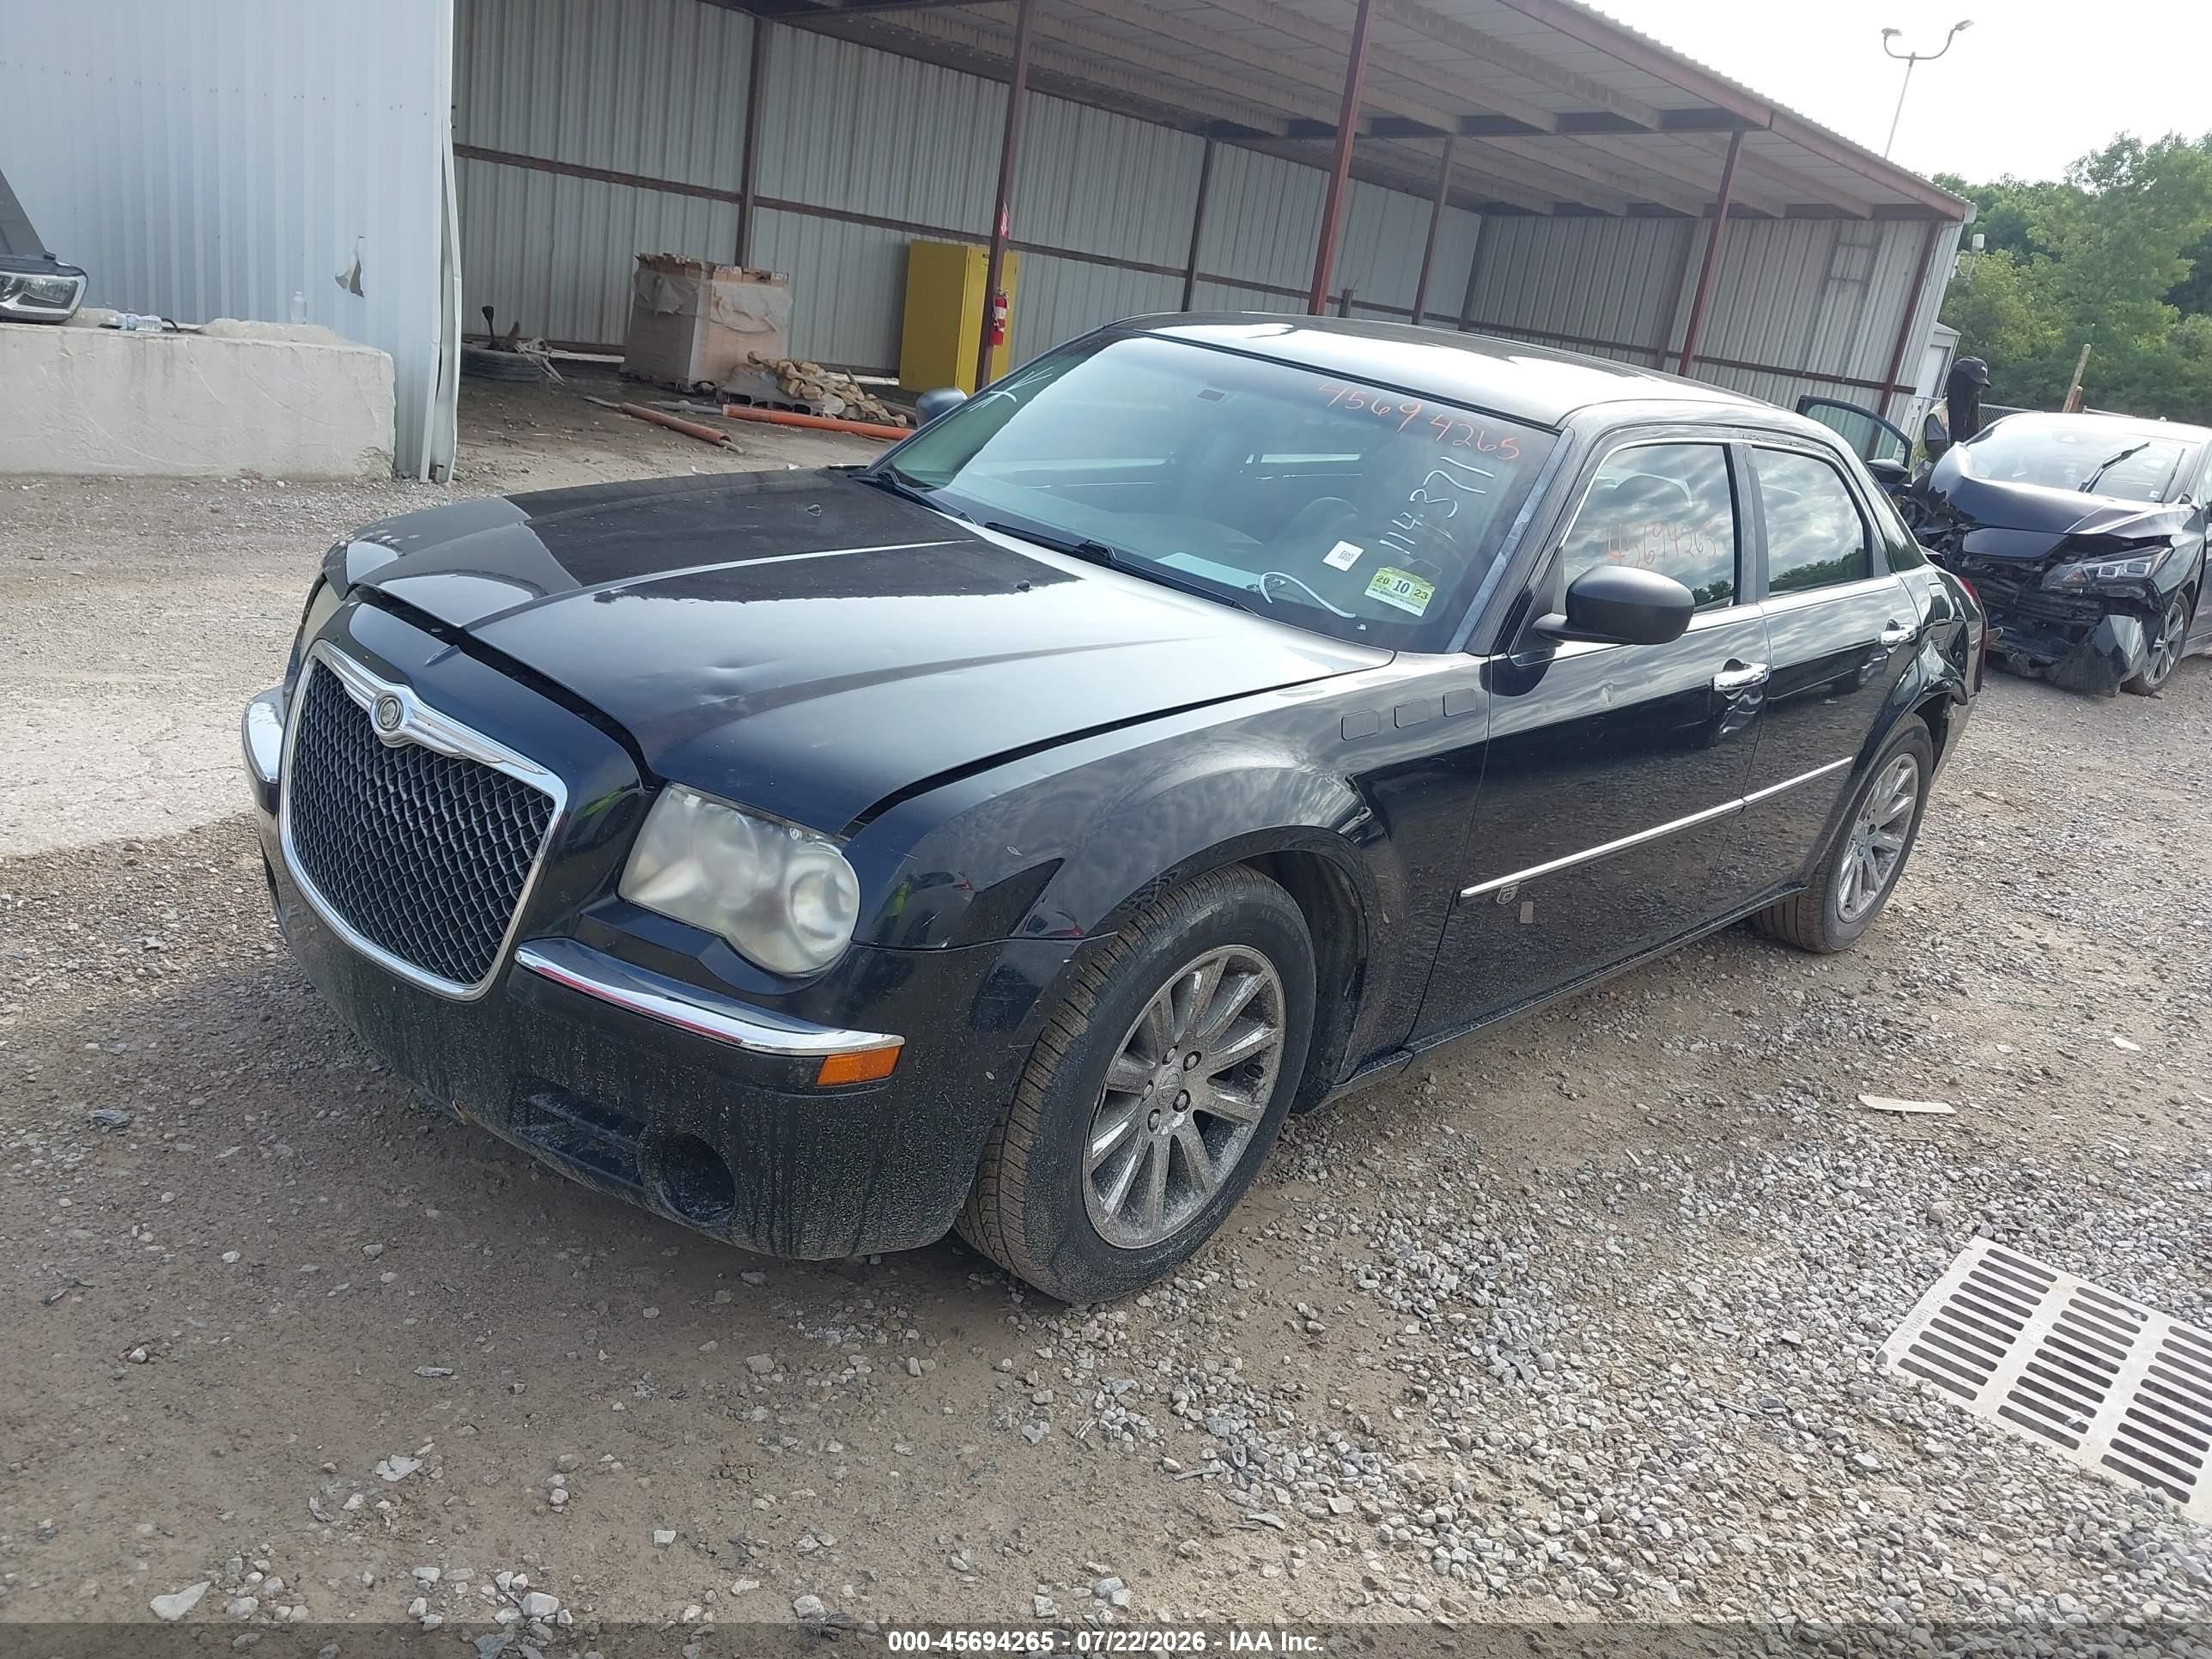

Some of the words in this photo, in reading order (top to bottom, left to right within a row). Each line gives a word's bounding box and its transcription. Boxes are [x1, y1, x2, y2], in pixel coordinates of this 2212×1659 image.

[1376, 574, 1391, 586] 20
[1392, 580, 1411, 594] 10
[1413, 588, 1429, 600] 23
